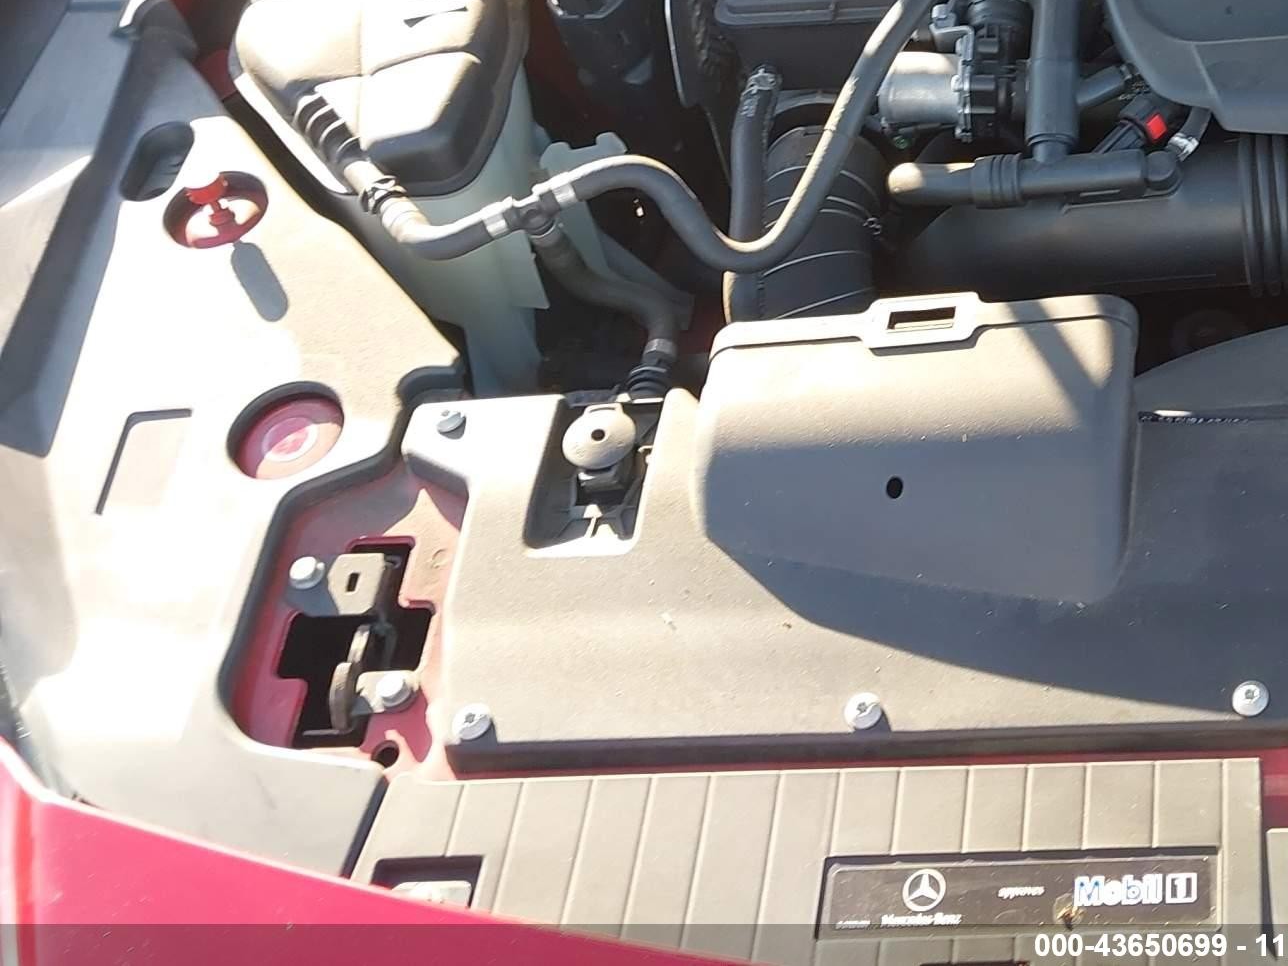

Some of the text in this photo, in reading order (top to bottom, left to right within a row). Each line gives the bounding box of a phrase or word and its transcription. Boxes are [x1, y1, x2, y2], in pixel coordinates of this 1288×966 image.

[1074, 874, 1196, 907] Mobil 1
[881, 913, 962, 928] Mercedes-Benz
